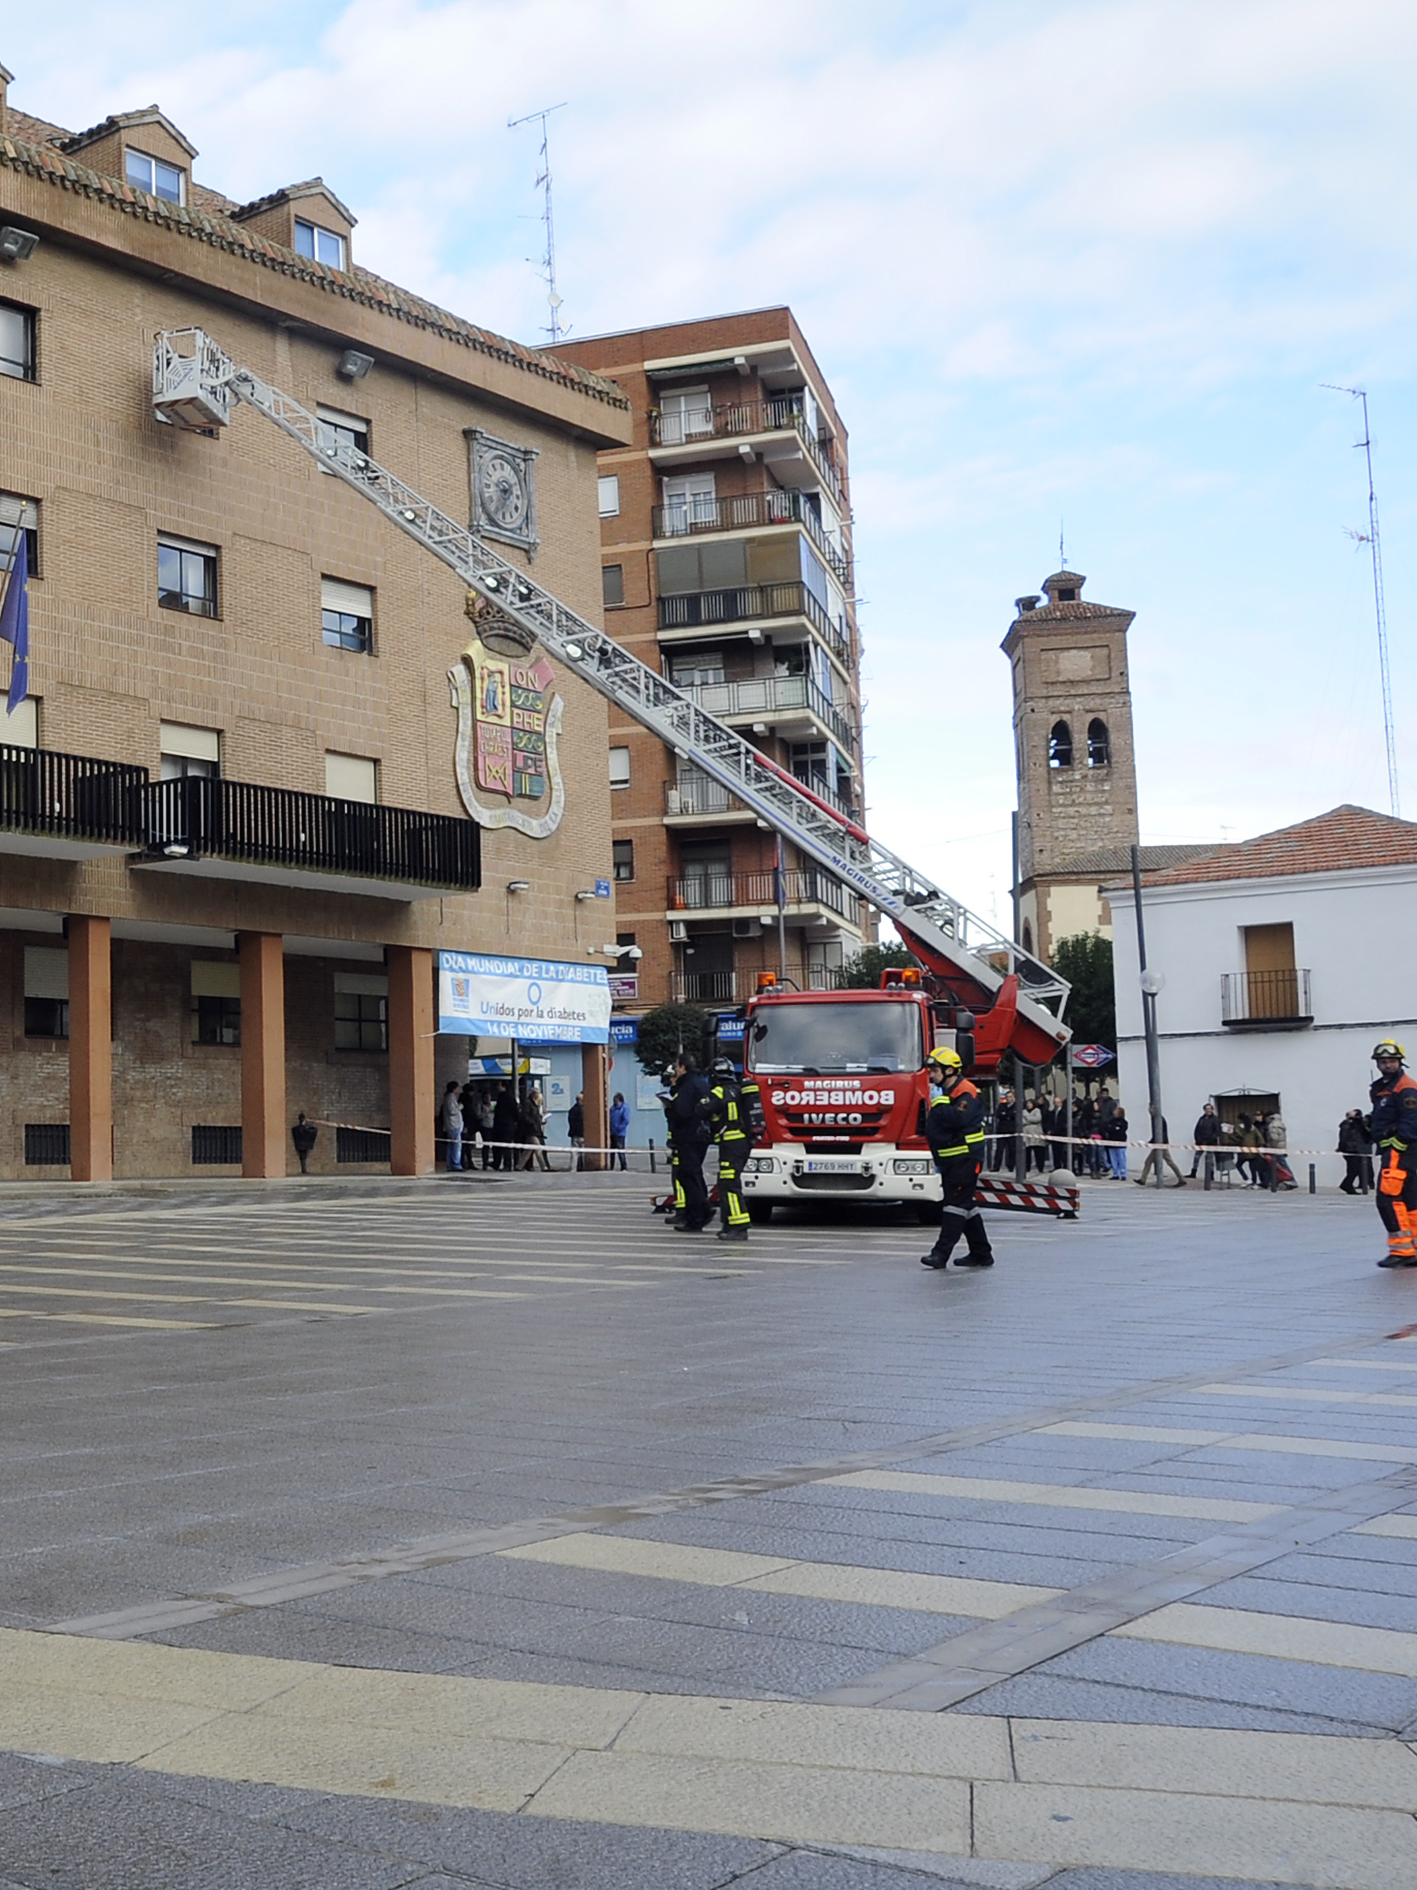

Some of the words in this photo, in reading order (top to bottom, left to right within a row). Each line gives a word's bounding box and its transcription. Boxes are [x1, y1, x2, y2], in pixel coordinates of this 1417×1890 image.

[512, 709, 544, 732] PHE
[832, 856, 878, 893] MAGIRUS
[467, 957, 521, 975] MUNDIAL
[523, 962, 539, 977] DE
[542, 964, 556, 979] LA
[558, 966, 609, 984] DIABETES
[481, 1001, 515, 1017] Unidos
[517, 1007, 534, 1021] por
[536, 1005, 544, 1018] la
[547, 1006, 586, 1021] diabetes
[487, 1021, 499, 1035] 14
[500, 1022, 517, 1037] DE
[518, 1024, 582, 1041] NOVIEMBRE
[803, 1080, 861, 1089] MAGIRUS
[803, 1113, 862, 1125] IVECO
[813, 1162, 835, 1171] 2769
